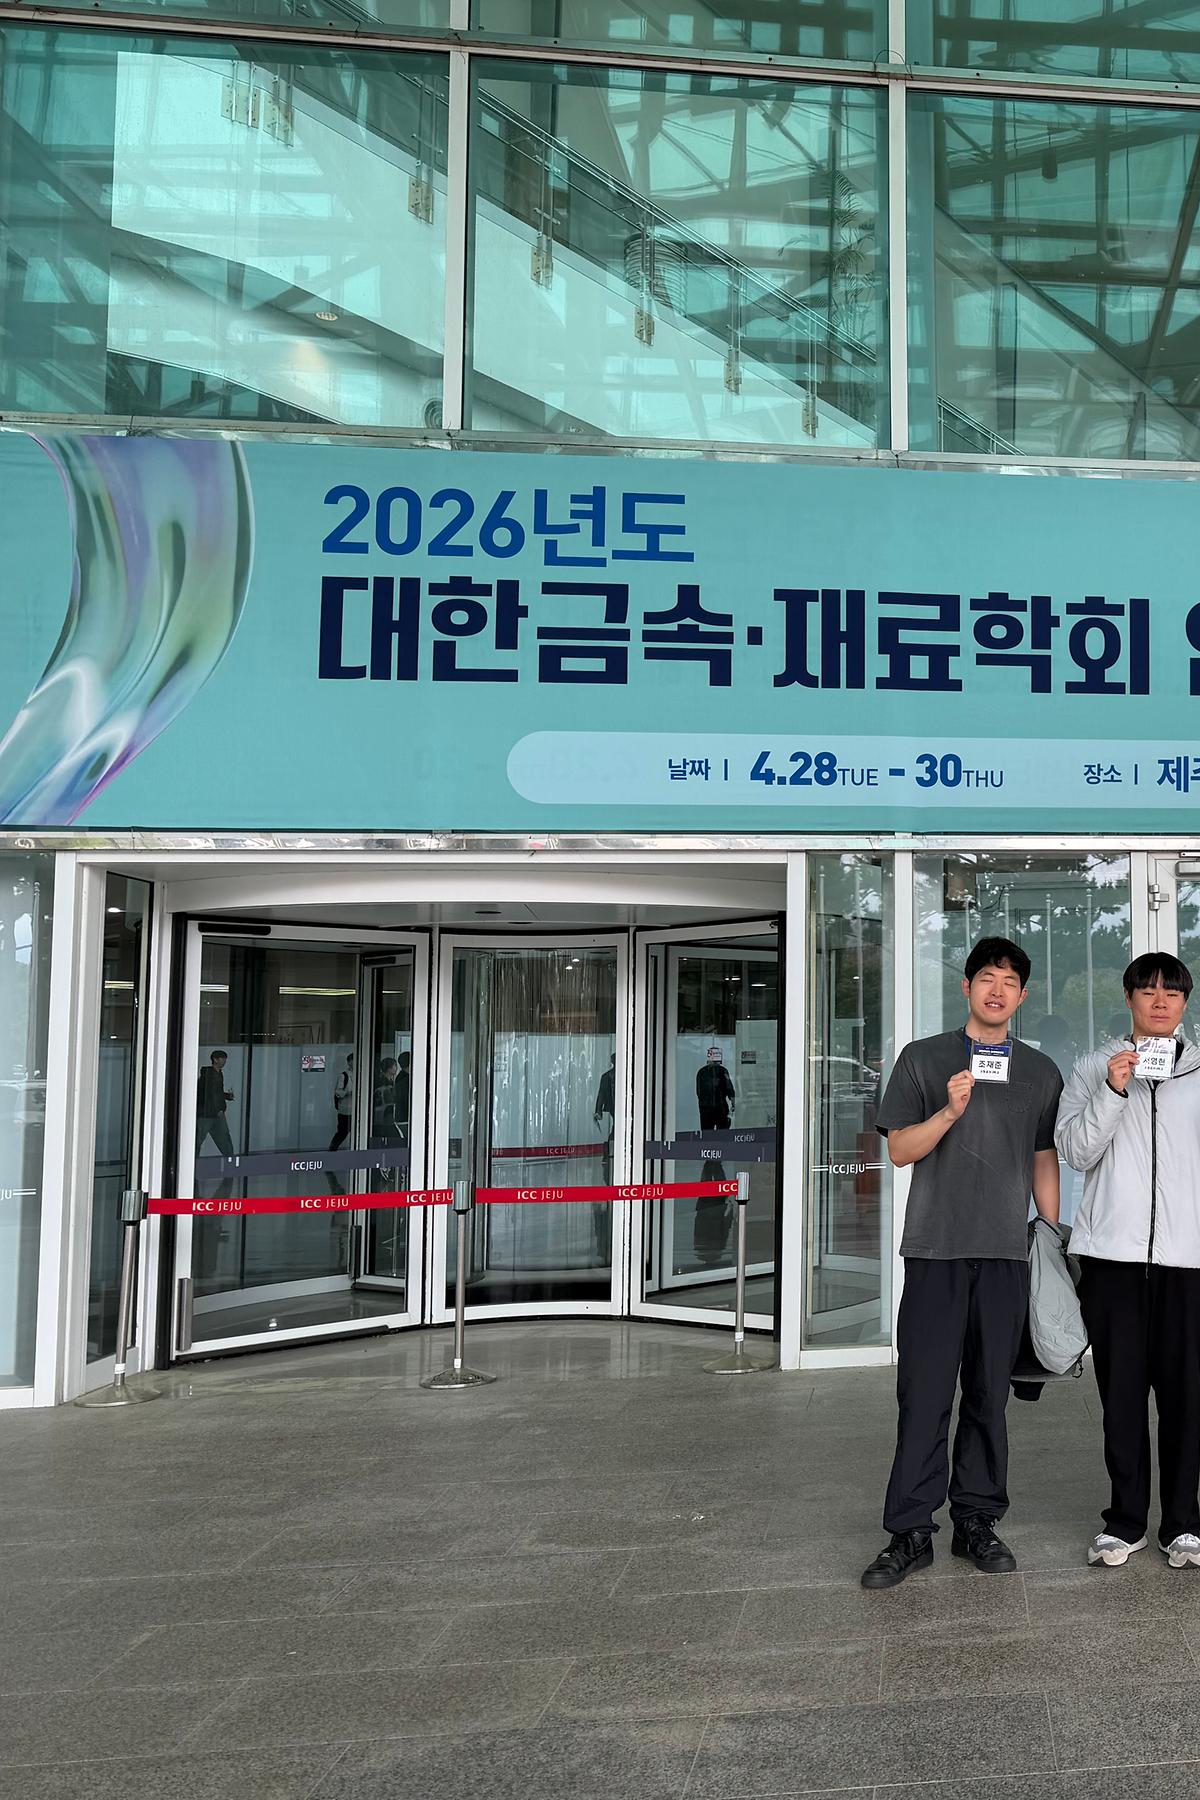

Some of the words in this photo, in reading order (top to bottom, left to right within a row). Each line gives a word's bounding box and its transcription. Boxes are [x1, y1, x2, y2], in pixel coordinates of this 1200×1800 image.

[322, 484, 695, 568] 2026년도
[318, 575, 1150, 696] 대한금속·재료학회
[668, 758, 711, 781] 날짜
[1083, 763, 1123, 785] 장소
[618, 1188, 638, 1197] ICC
[642, 1187, 664, 1198] JEJU
[718, 1183, 738, 1193] ICC
[406, 1193, 427, 1203] ICC
[431, 1191, 454, 1203] JEJU
[517, 1190, 537, 1200] ICC
[541, 1190, 564, 1201] JEJU
[192, 1201, 214, 1211] ICC
[218, 1201, 242, 1212] JEJU
[300, 1199, 322, 1209] ICC
[325, 1198, 349, 1209] JEJU
